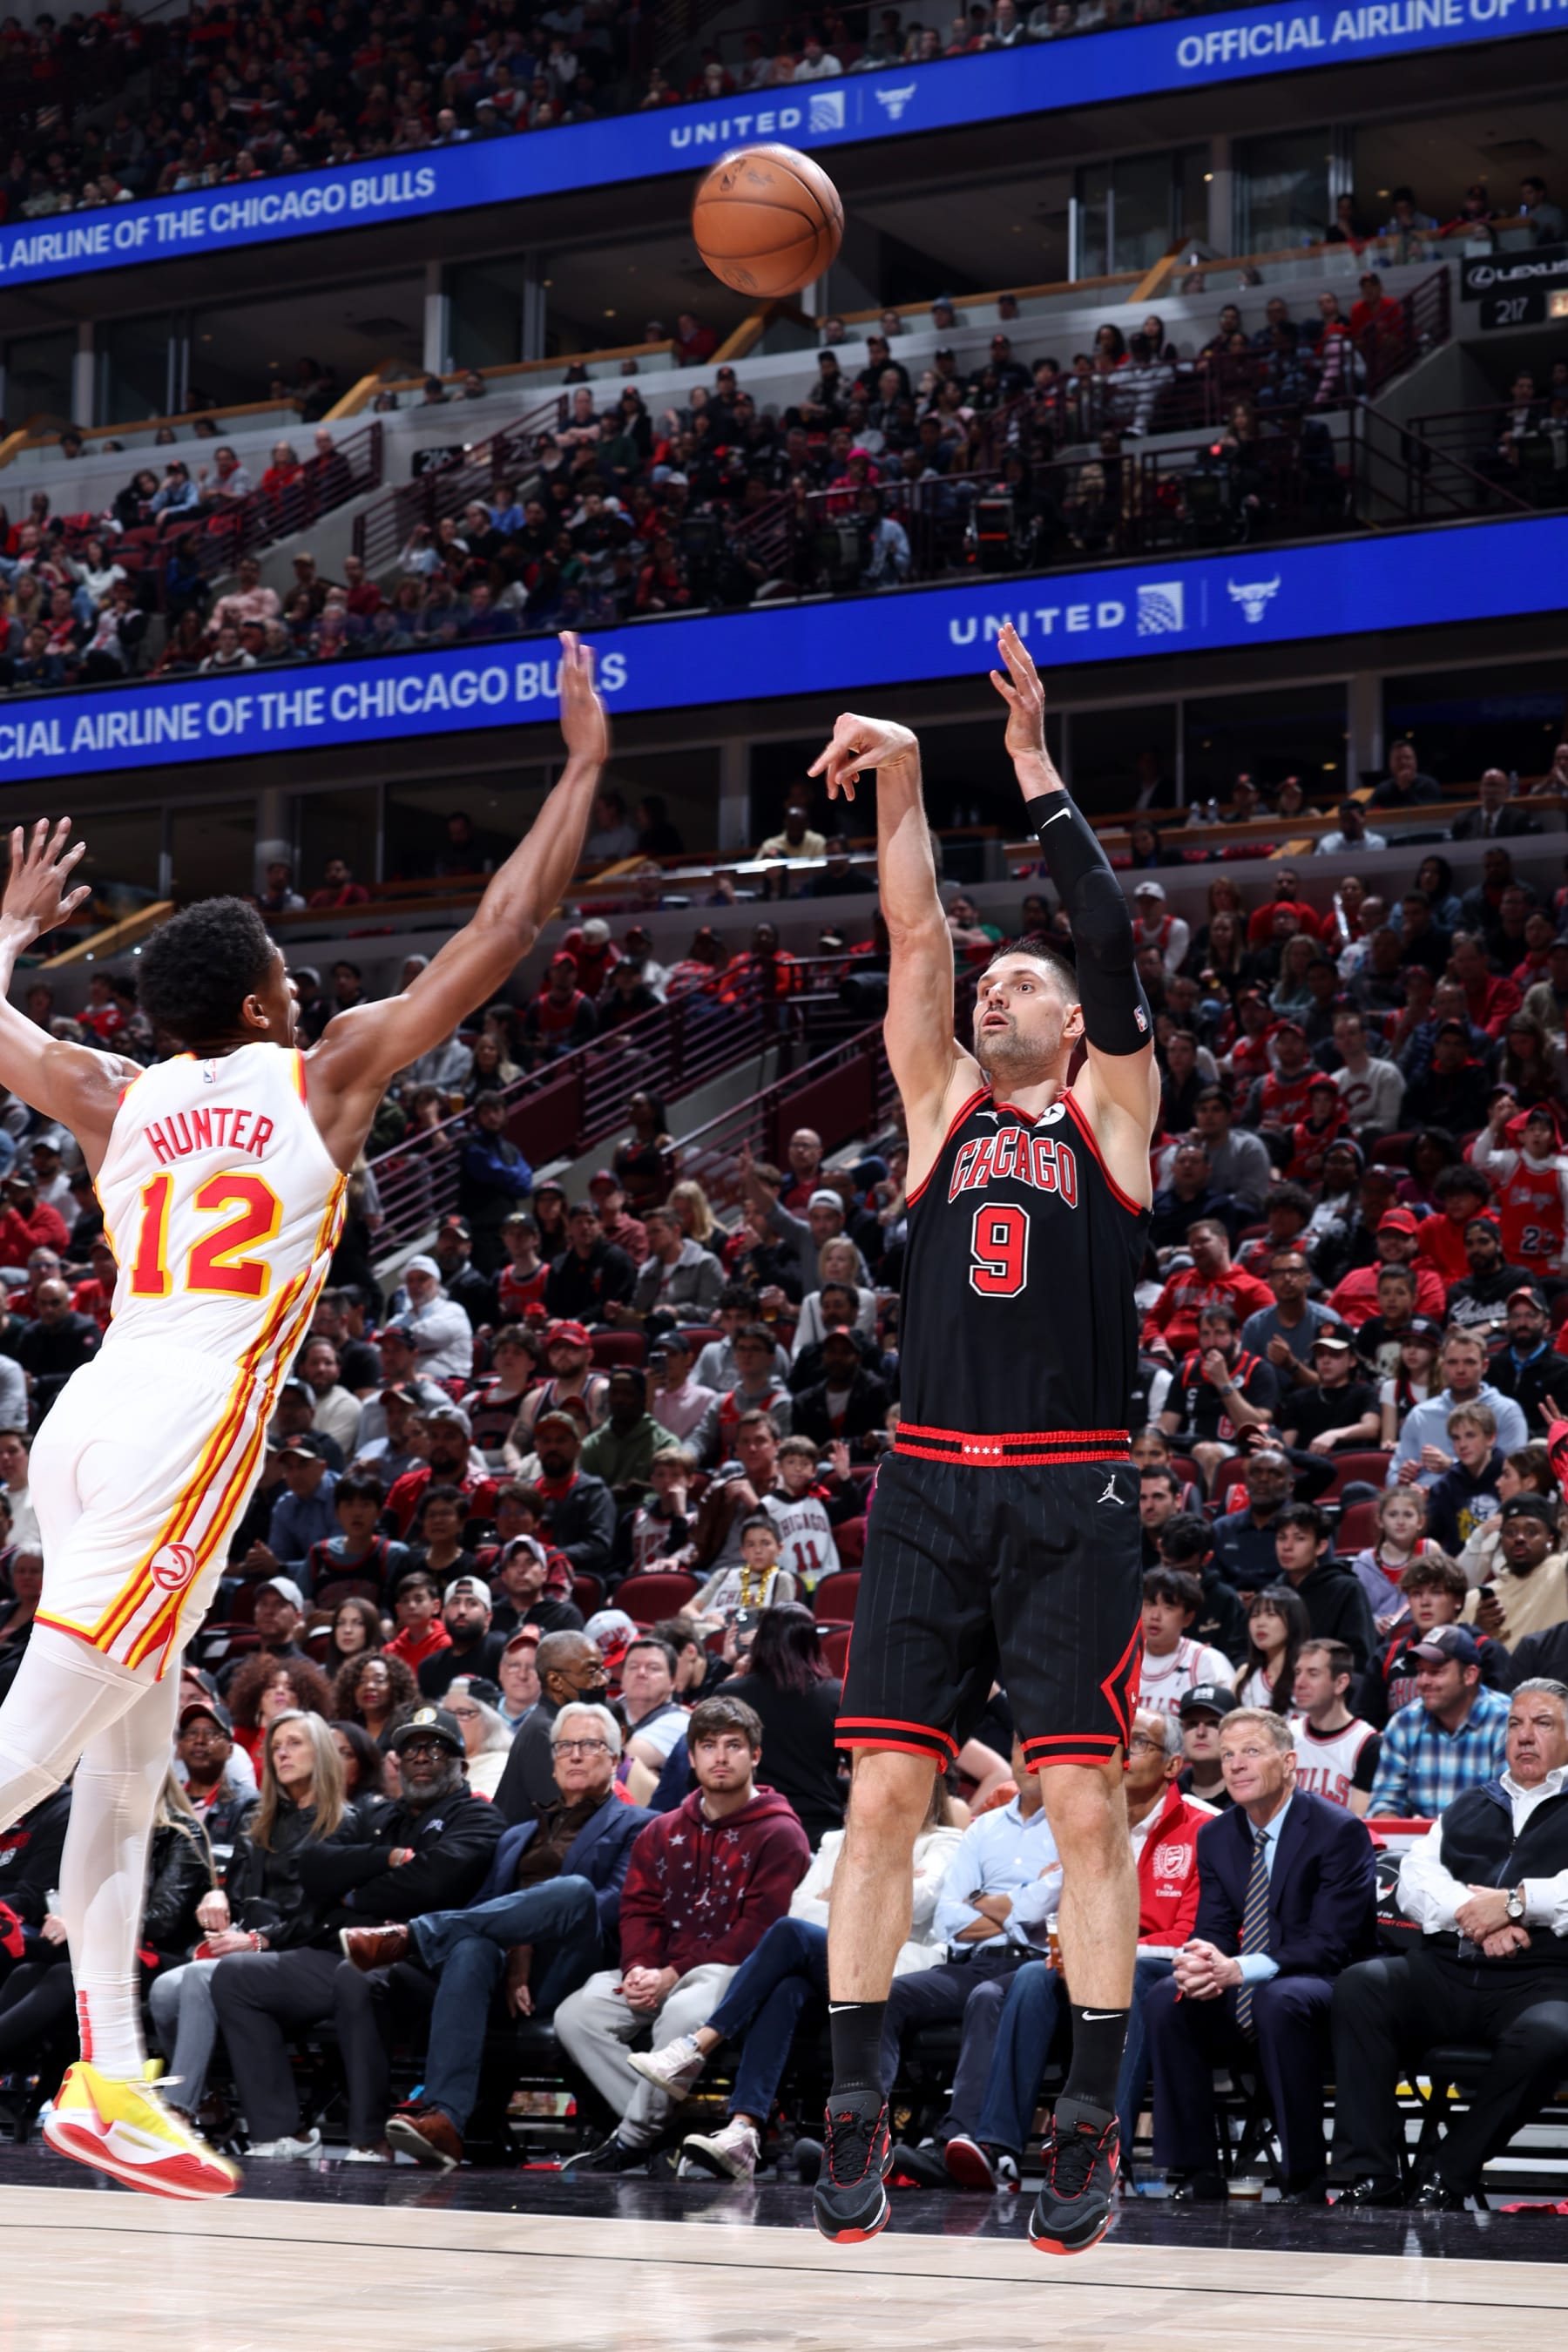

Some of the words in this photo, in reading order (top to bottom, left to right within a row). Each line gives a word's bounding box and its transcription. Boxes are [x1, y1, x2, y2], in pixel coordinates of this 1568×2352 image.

[1177, 16, 1326, 68] OFFICIAL
[1330, 0, 1463, 44] AIRLINE
[670, 108, 801, 148] UNITED
[9, 223, 111, 268] AIRLINE
[114, 216, 149, 249] OF
[154, 206, 206, 243] THE
[209, 184, 346, 233] CHICAGO
[350, 167, 435, 210] BULLS
[1495, 297, 1529, 324] 217
[950, 601, 1125, 645] UNITED
[71, 703, 201, 754] AIRLINE
[206, 696, 253, 737] OF
[258, 686, 325, 731] THE
[331, 667, 509, 722] CHICAGO
[143, 1108, 274, 1166] HUNTER
[129, 1170, 284, 1301] 12
[969, 1202, 1031, 1299] 9
[792, 1539, 821, 1573] 11
[1295, 1767, 1351, 1808] ULLS
